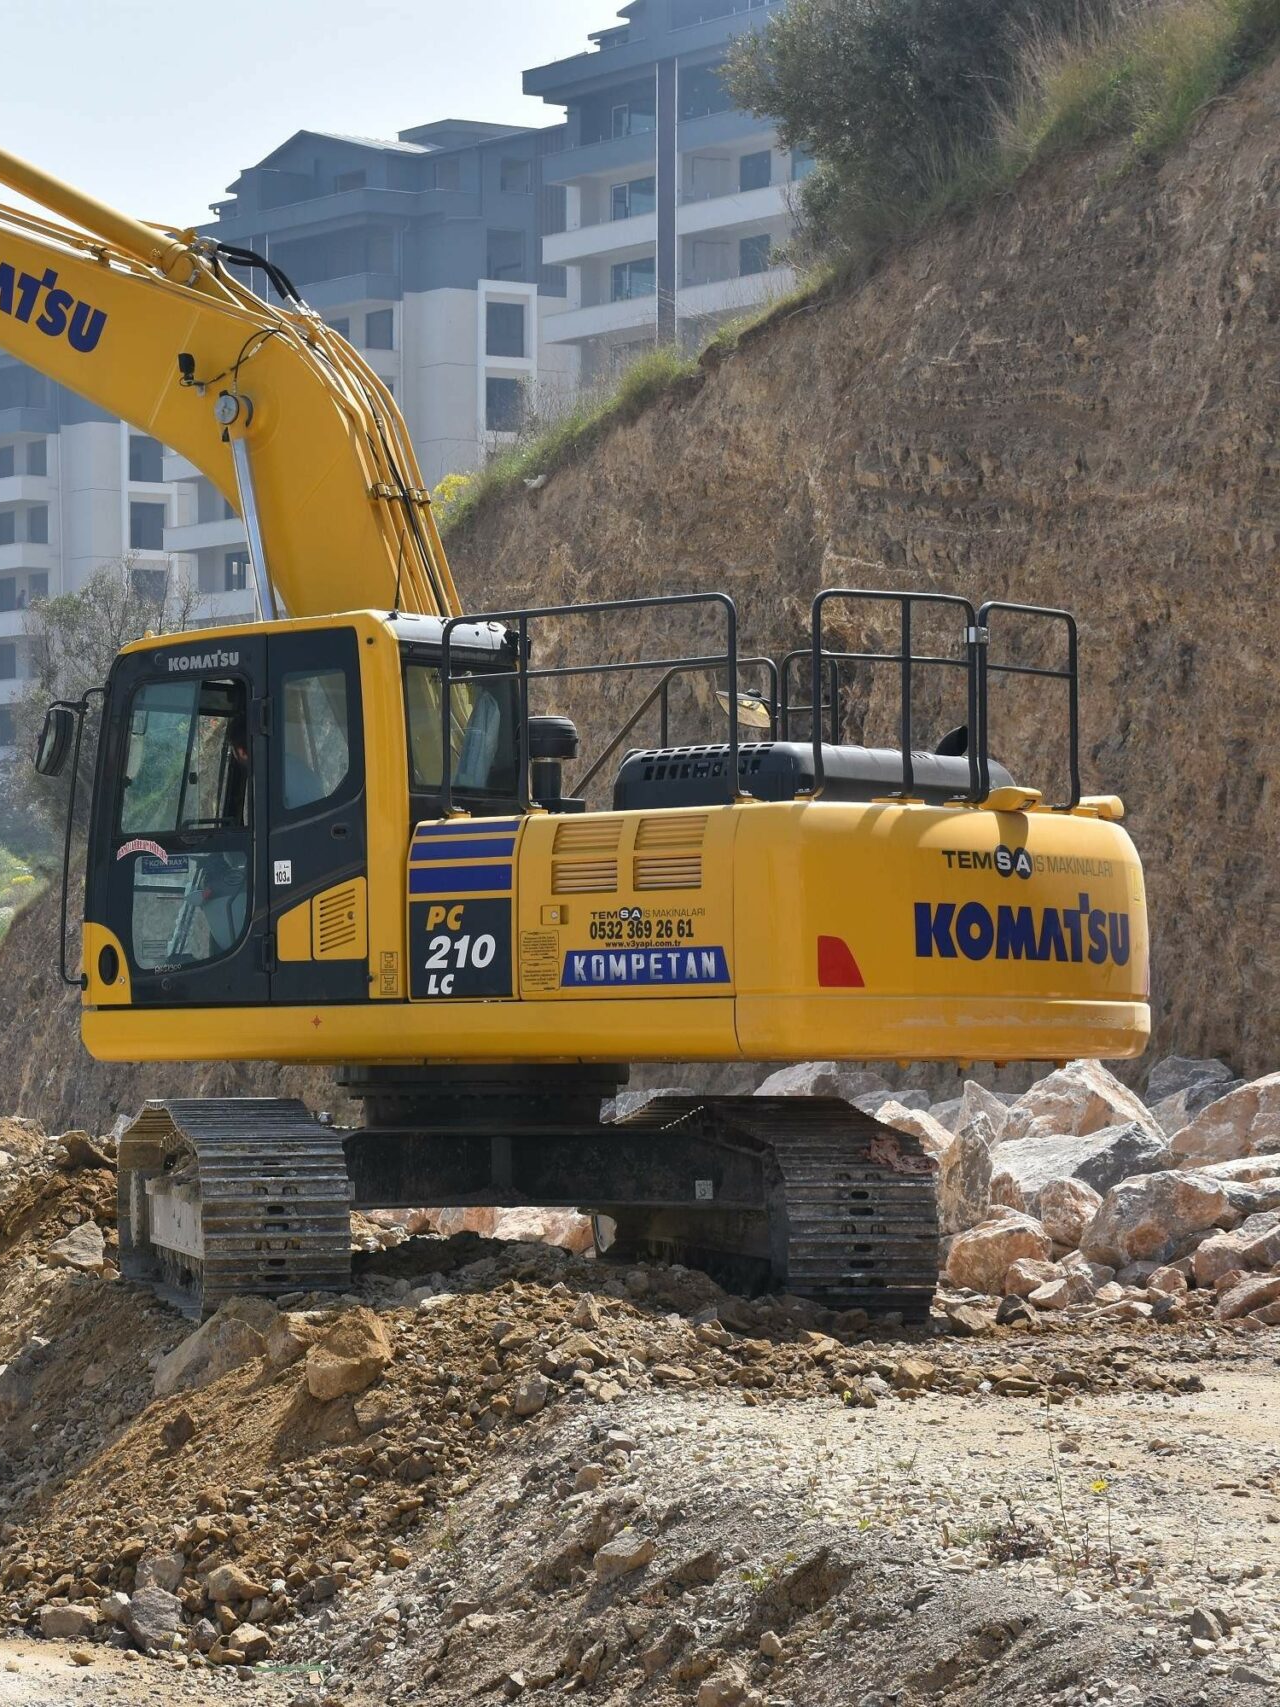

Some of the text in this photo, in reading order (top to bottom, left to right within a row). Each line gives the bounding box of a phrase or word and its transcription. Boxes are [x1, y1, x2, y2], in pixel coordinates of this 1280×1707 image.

[168, 649, 239, 671] KOMATSU
[942, 846, 1032, 877] TEMSA
[276, 871, 286, 883] 103
[426, 905, 464, 931] PC
[590, 907, 642, 920] TEMSA
[590, 918, 694, 939] 0532 369 26 61
[914, 893, 1130, 966] KOMATSU
[425, 934, 496, 969] 210
[605, 940, 681, 949] www.v3yapi.com.tr
[573, 952, 716, 982] KOMPETAN
[427, 974, 455, 995] LC
